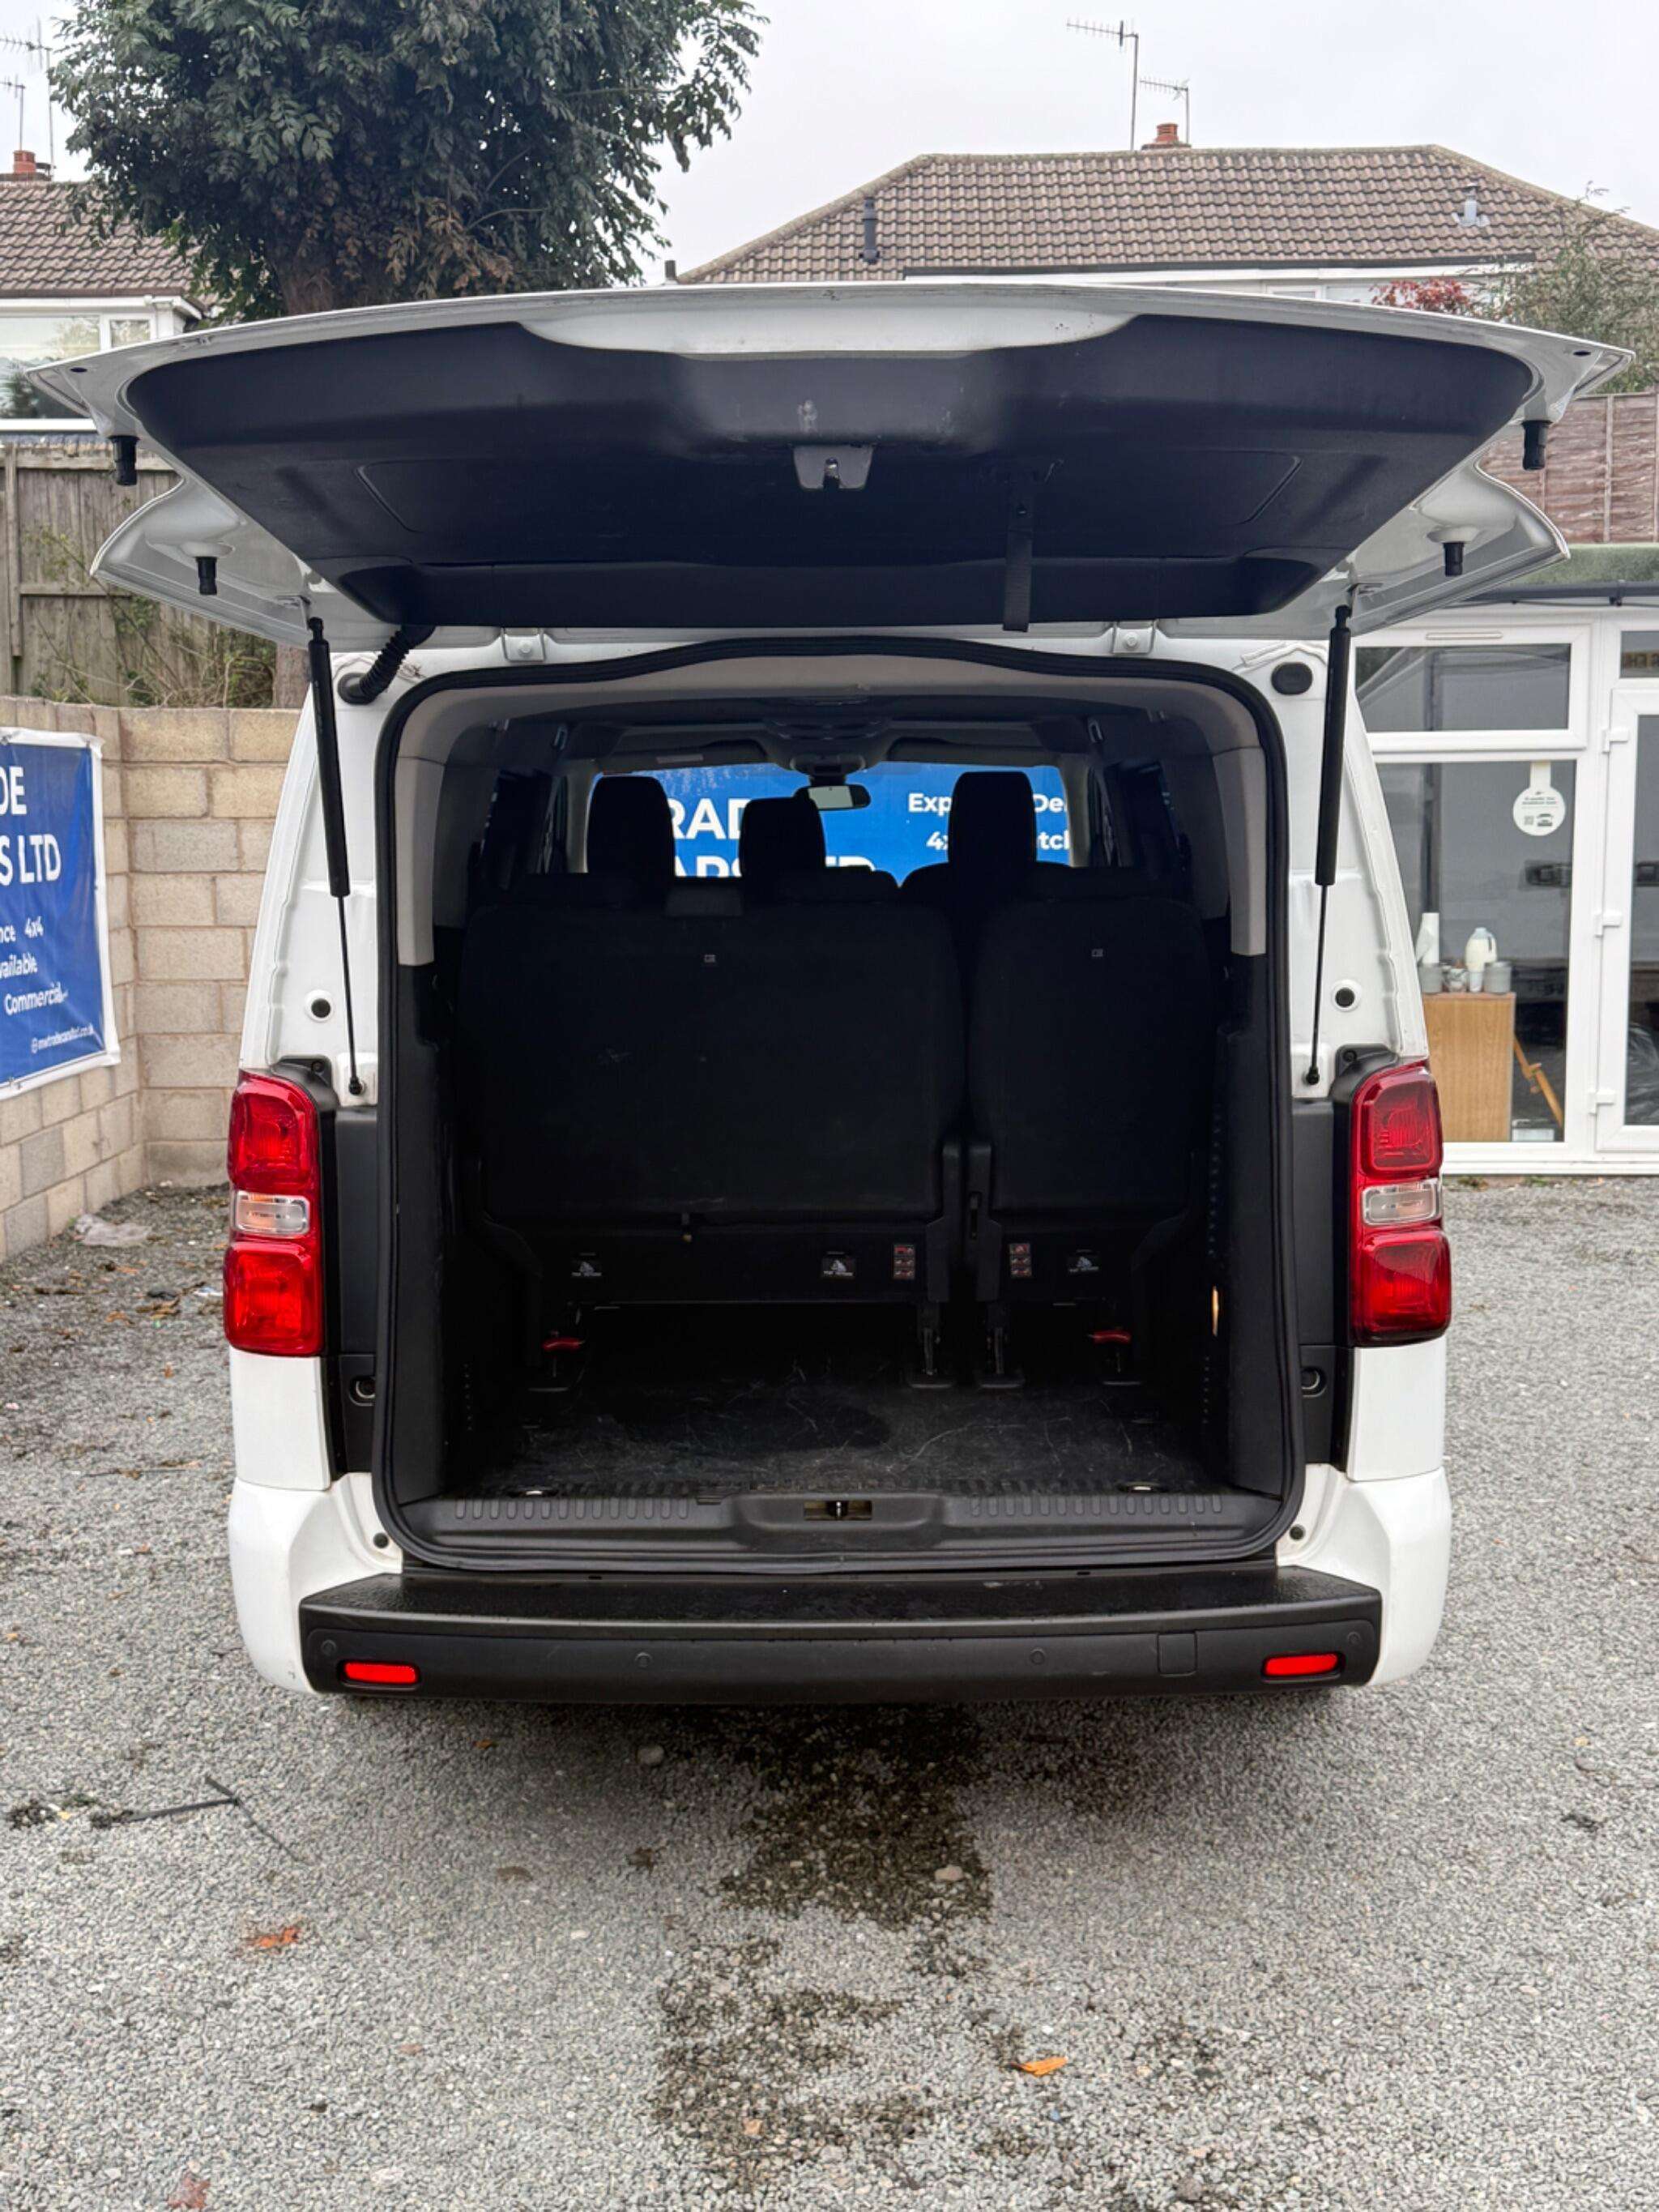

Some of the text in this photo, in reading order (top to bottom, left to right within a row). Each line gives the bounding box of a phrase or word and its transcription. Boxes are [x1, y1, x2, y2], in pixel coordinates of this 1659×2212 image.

[18, 833, 61, 883] LTD
[24, 915, 44, 939] 4x4
[0, 951, 38, 980] ailable
